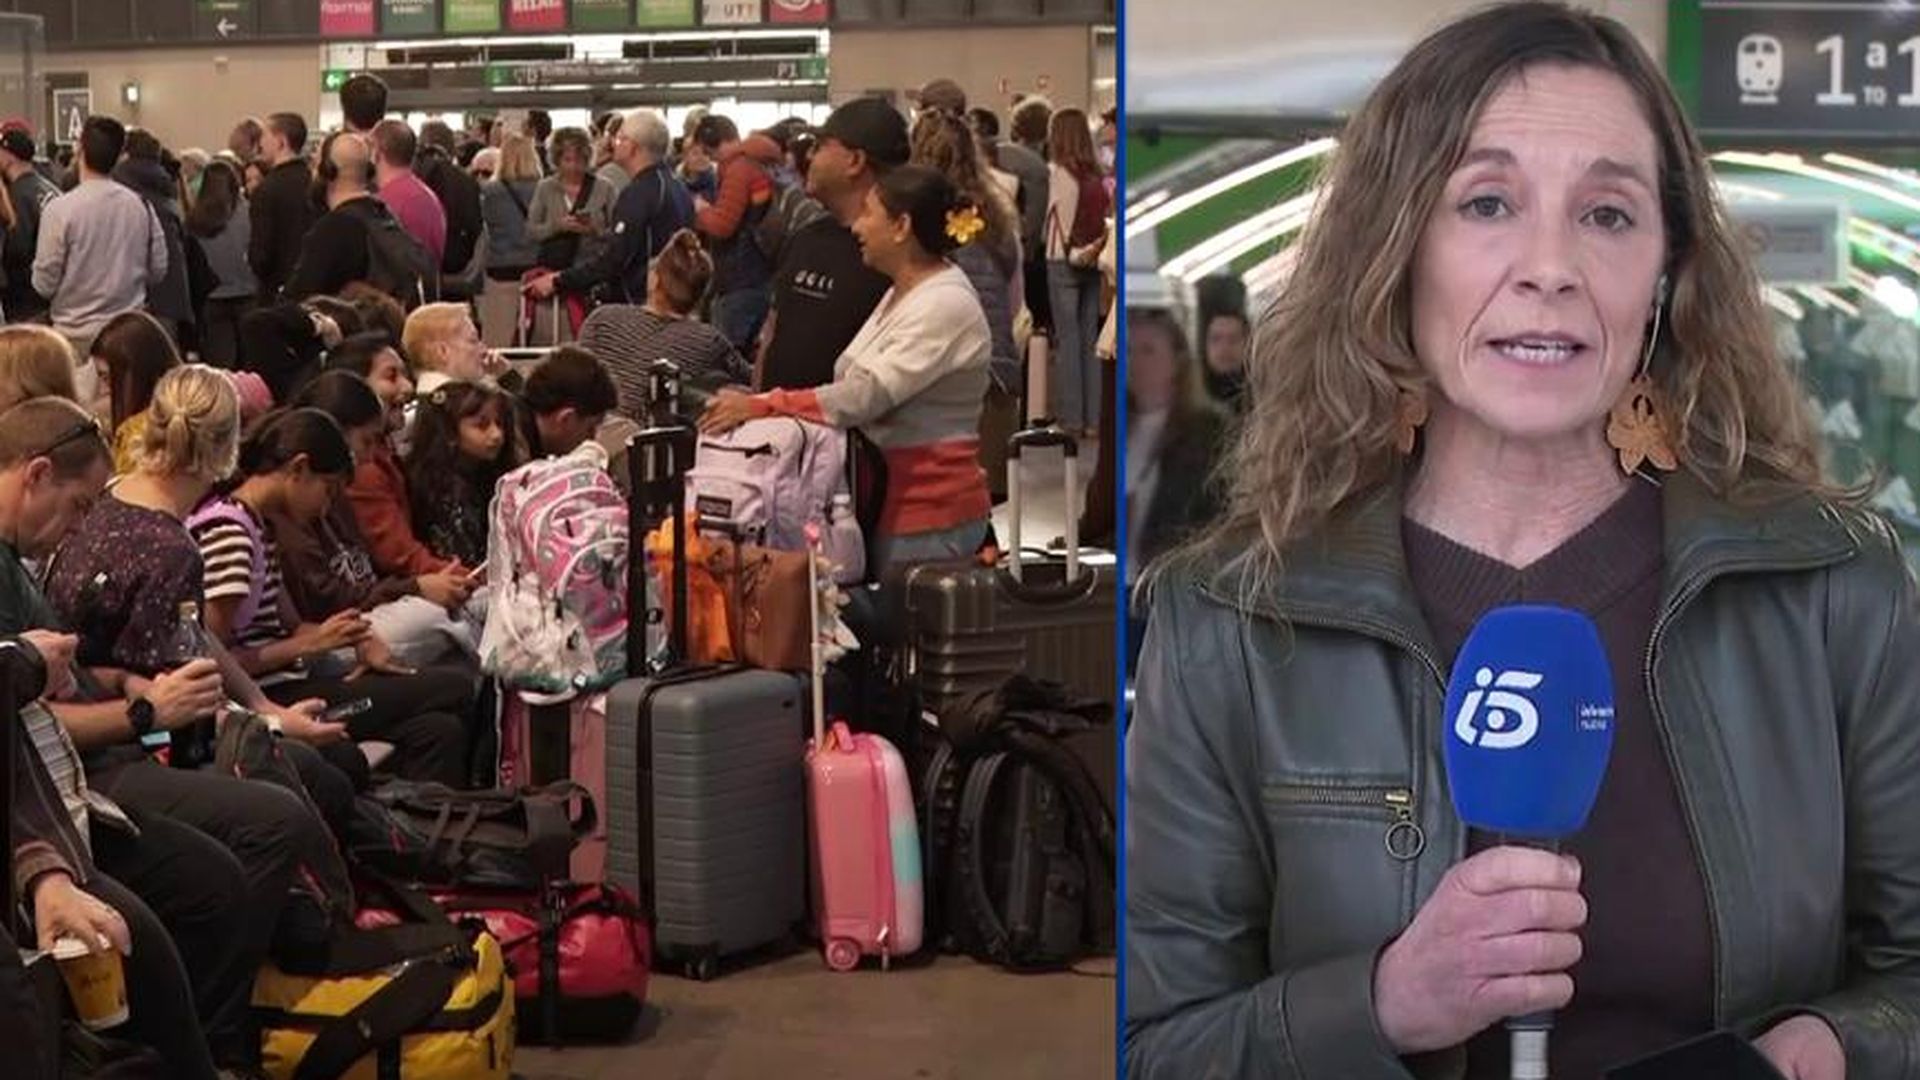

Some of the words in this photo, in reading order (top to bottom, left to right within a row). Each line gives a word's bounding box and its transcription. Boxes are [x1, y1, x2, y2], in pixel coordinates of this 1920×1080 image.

[1816, 35, 1856, 105] 1
[1866, 42, 1887, 68] a
[68, 105, 83, 140] A
